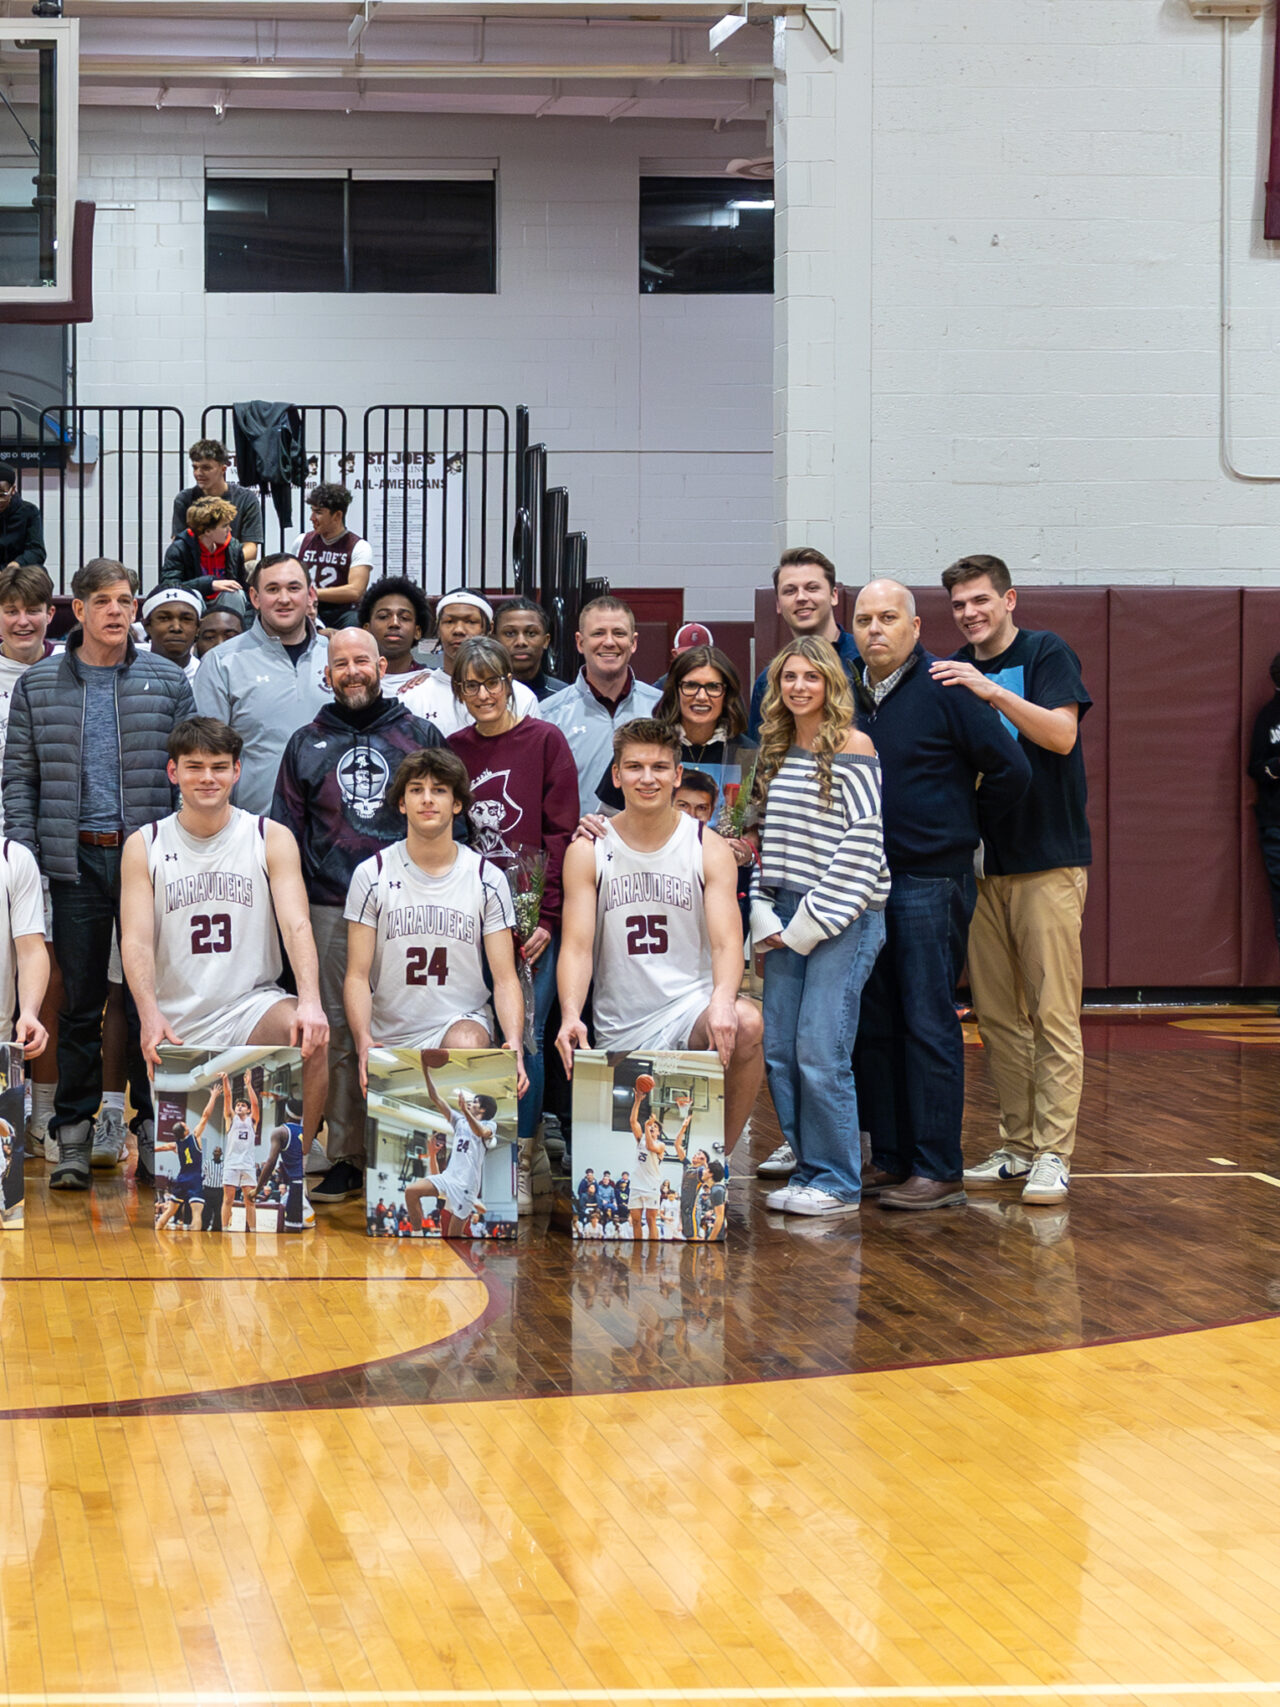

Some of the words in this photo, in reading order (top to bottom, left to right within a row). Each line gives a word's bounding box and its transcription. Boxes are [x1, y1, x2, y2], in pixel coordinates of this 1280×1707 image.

[367, 452, 385, 465] ST
[354, 479, 447, 489] AL-AMERICANS
[303, 550, 317, 562] ST.
[319, 551, 348, 565] JOE'S
[309, 565, 337, 589] 12
[165, 872, 253, 914] MARAUDERS
[190, 913, 232, 954] 23
[625, 914, 668, 955] 25
[406, 946, 449, 986] 24
[456, 1138, 470, 1153] 24
